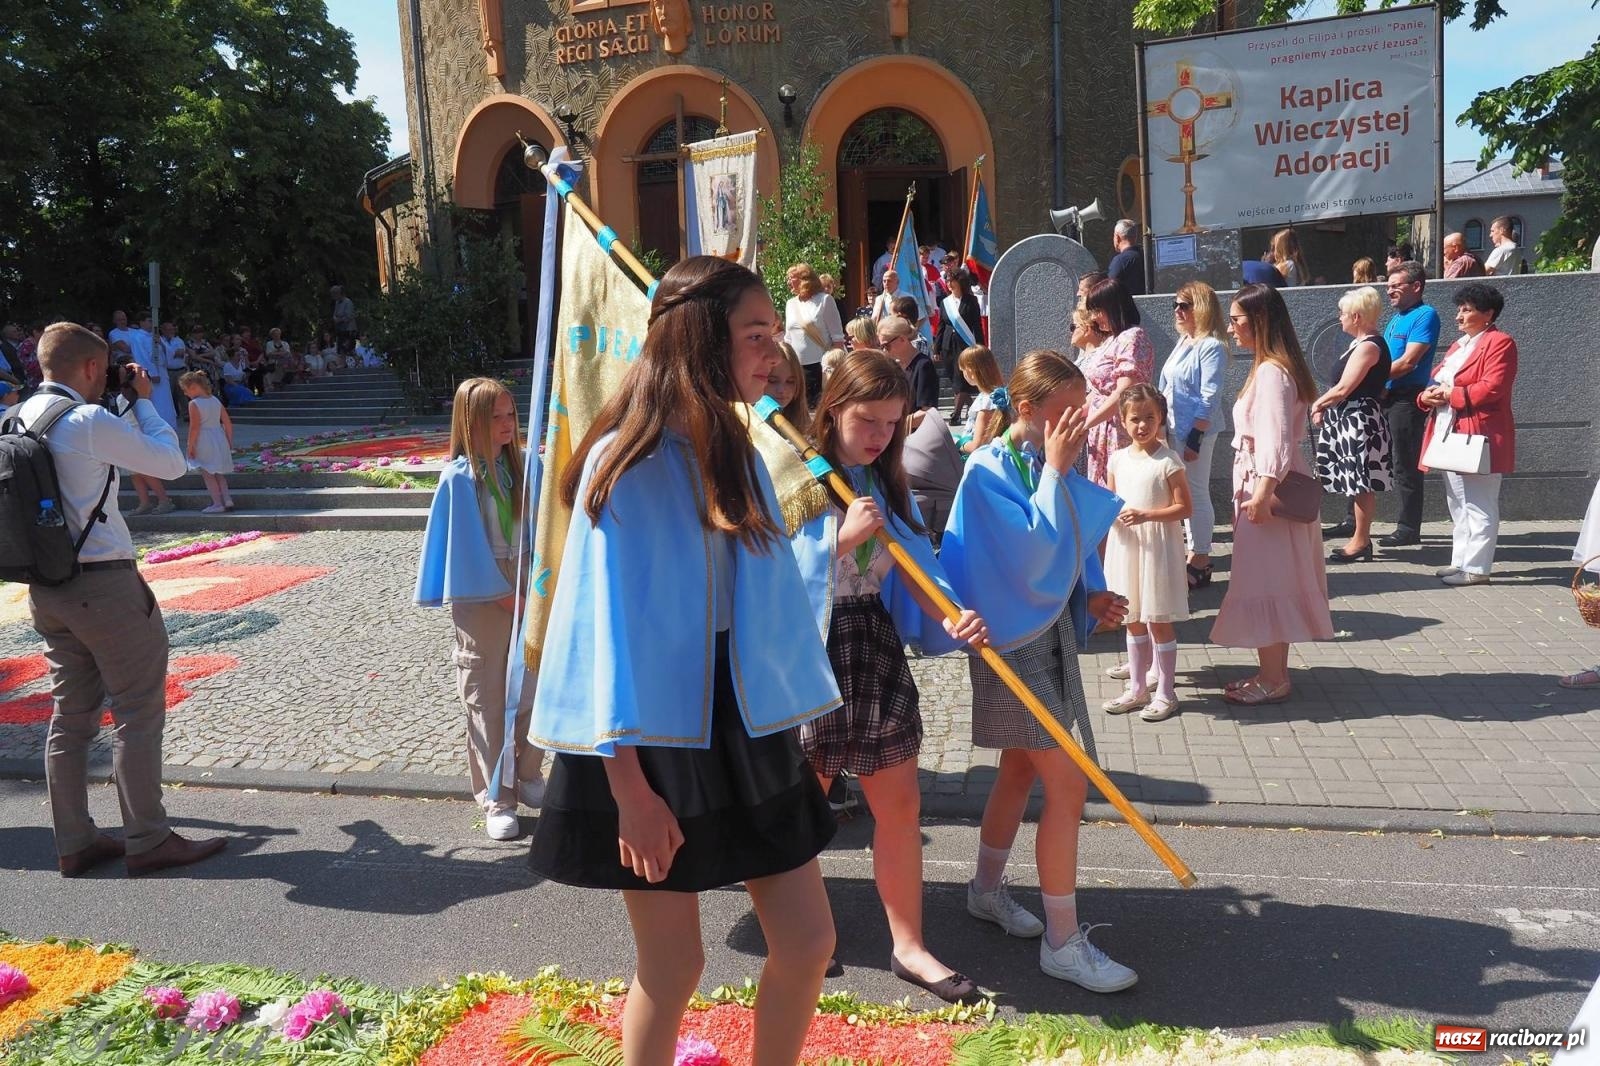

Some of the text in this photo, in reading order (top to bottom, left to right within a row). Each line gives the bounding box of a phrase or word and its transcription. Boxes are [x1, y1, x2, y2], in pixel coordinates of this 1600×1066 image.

[702, 2, 775, 25] HONOR
[555, 13, 649, 44] GLORIA ET
[705, 24, 781, 46] LORUM
[1247, 39, 1288, 52] Przyszli
[1292, 36, 1305, 45] do
[1308, 30, 1337, 42] Filipa
[556, 43, 593, 65] REGI
[1270, 51, 1327, 65] pragniemy
[1330, 43, 1378, 57] zobaczyć
[1280, 78, 1383, 112] Kaplica
[1254, 105, 1410, 146] Wieczystej
[1274, 141, 1390, 177] Adoracji
[1237, 205, 1275, 217] wejście
[1278, 204, 1291, 214] od
[1294, 201, 1330, 214] prawej
[1333, 196, 1367, 207] strony
